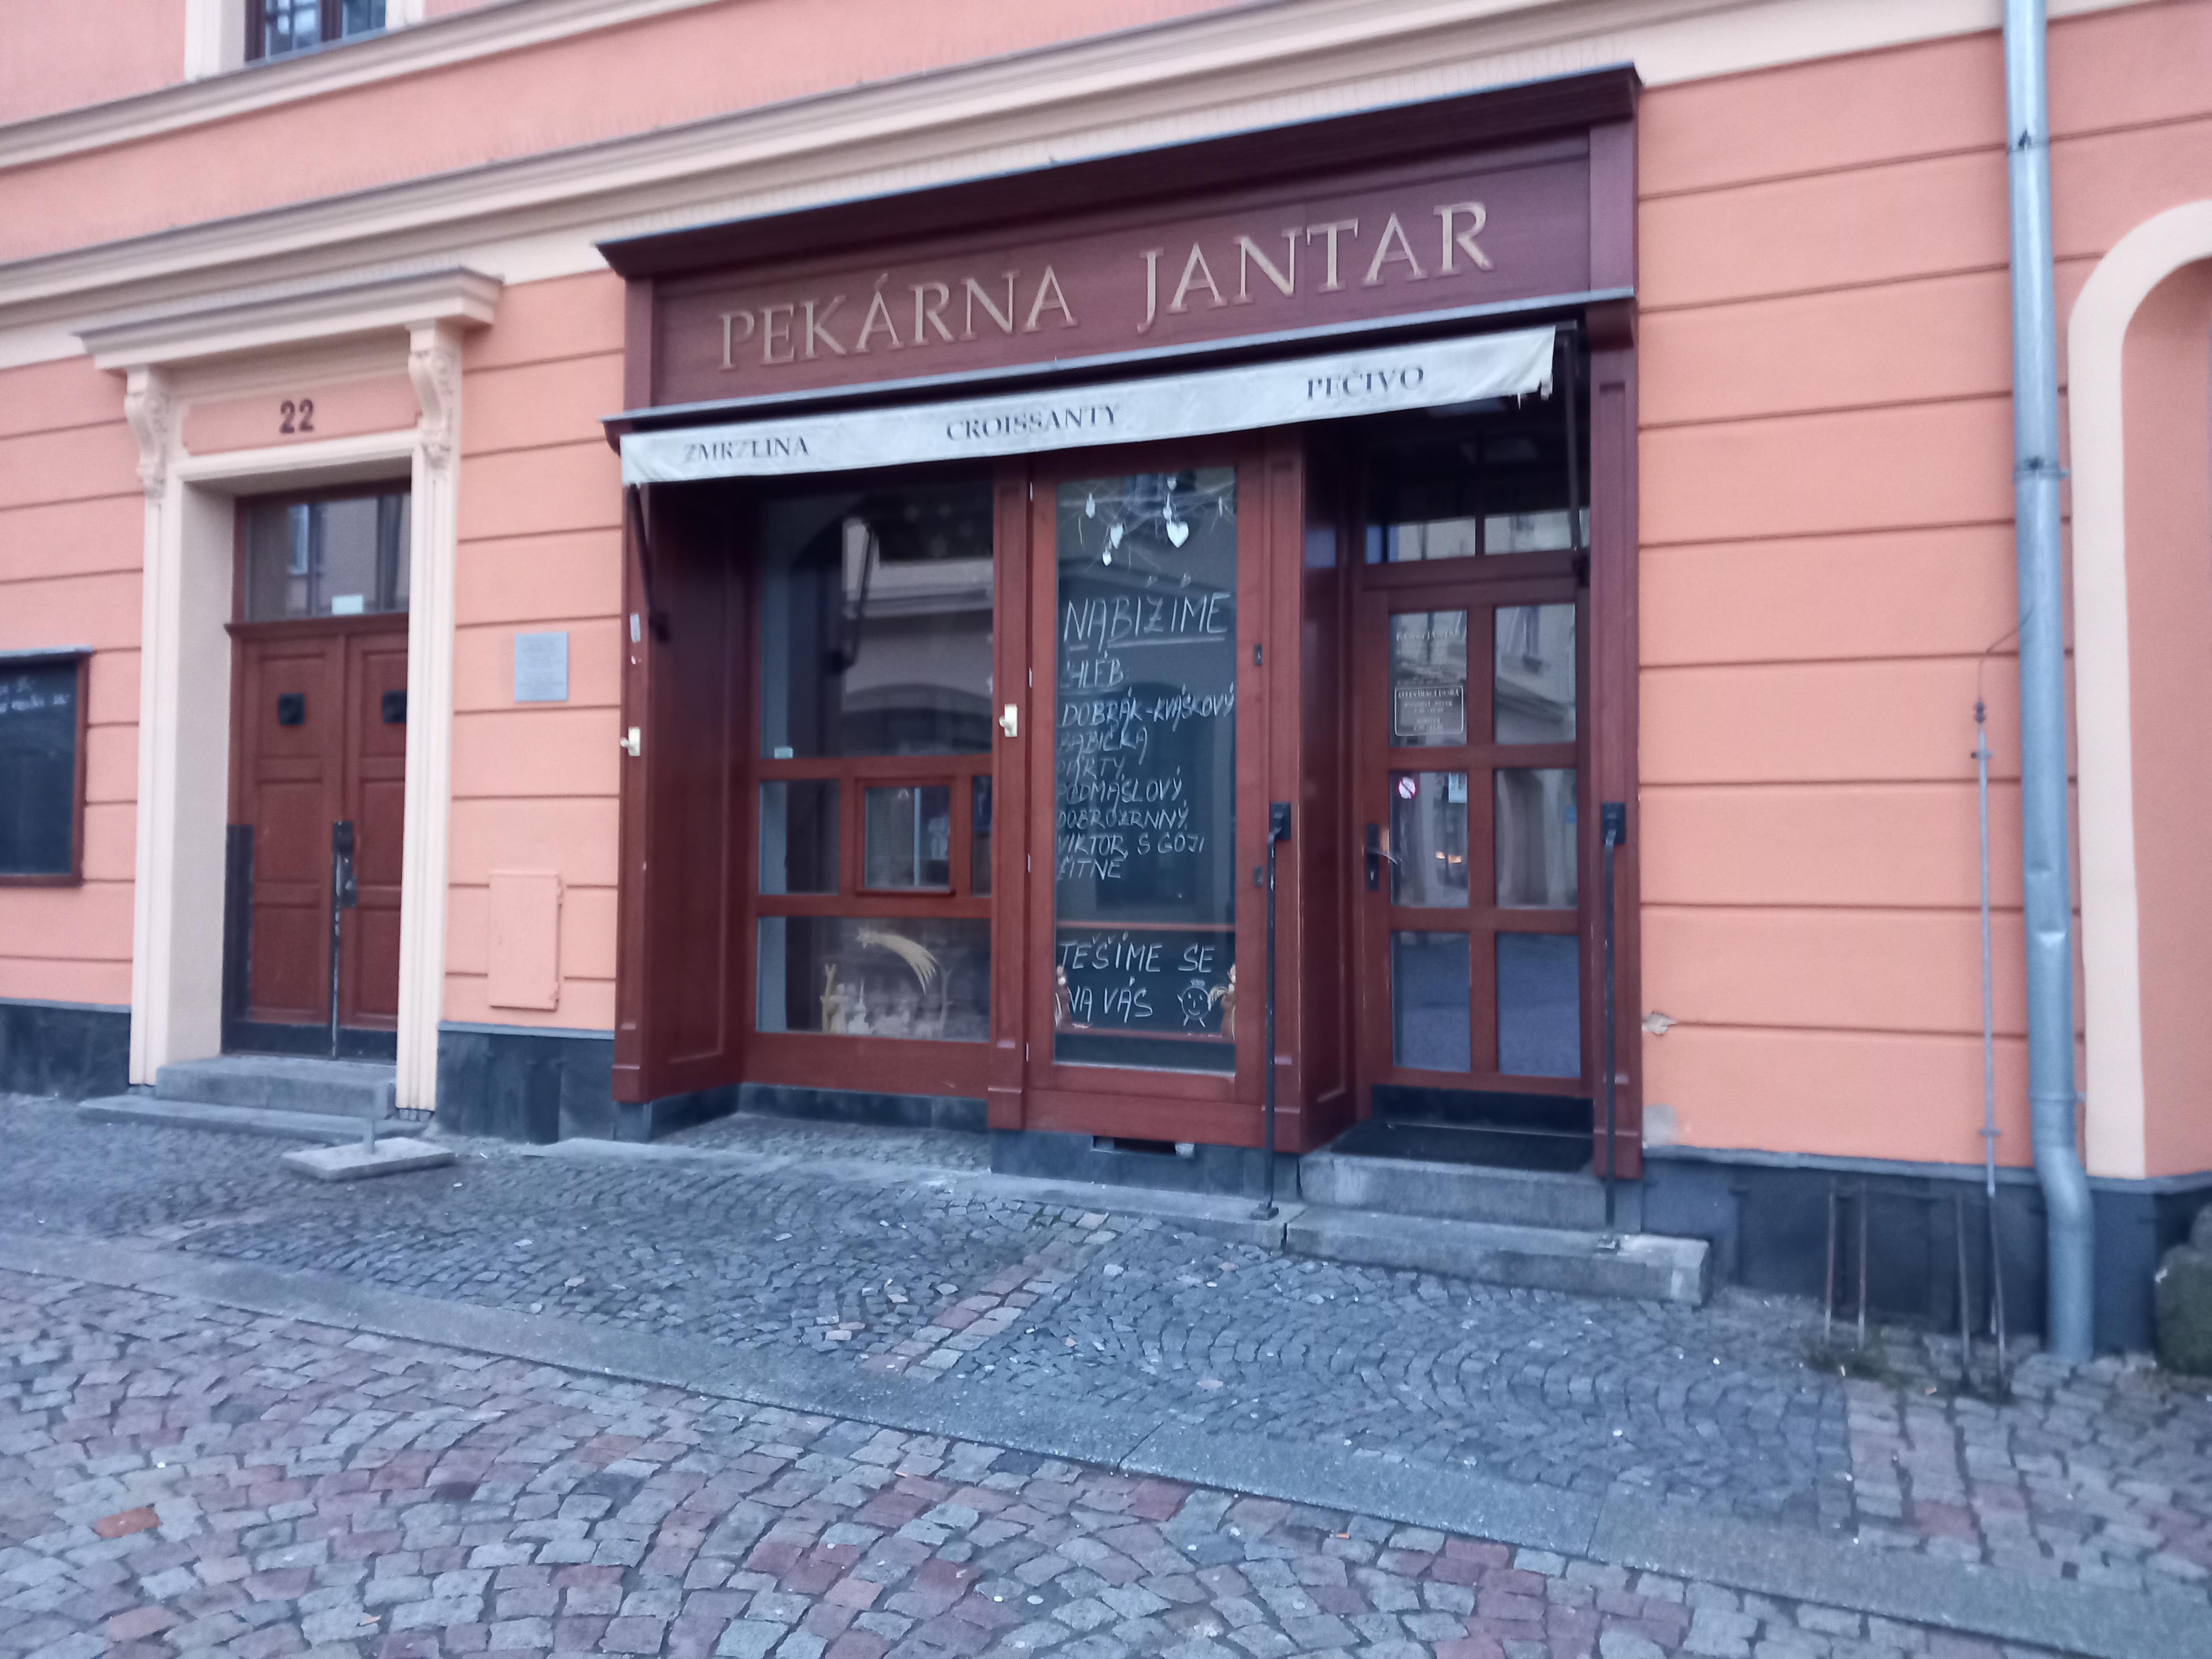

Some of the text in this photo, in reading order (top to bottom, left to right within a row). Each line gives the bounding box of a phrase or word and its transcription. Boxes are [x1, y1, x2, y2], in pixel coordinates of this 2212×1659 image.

[718, 201, 1493, 371] PEKÁRNA JANTAR
[279, 398, 314, 434] 22
[946, 403, 1120, 440] CROISSANTY
[683, 436, 810, 462] ZMRZLINA
[1137, 832, 1151, 855] S
[1157, 832, 1205, 854] GOJI
[1058, 931, 1215, 973] TĚŠÍME SE
[1104, 975, 1154, 1023] VÁS
